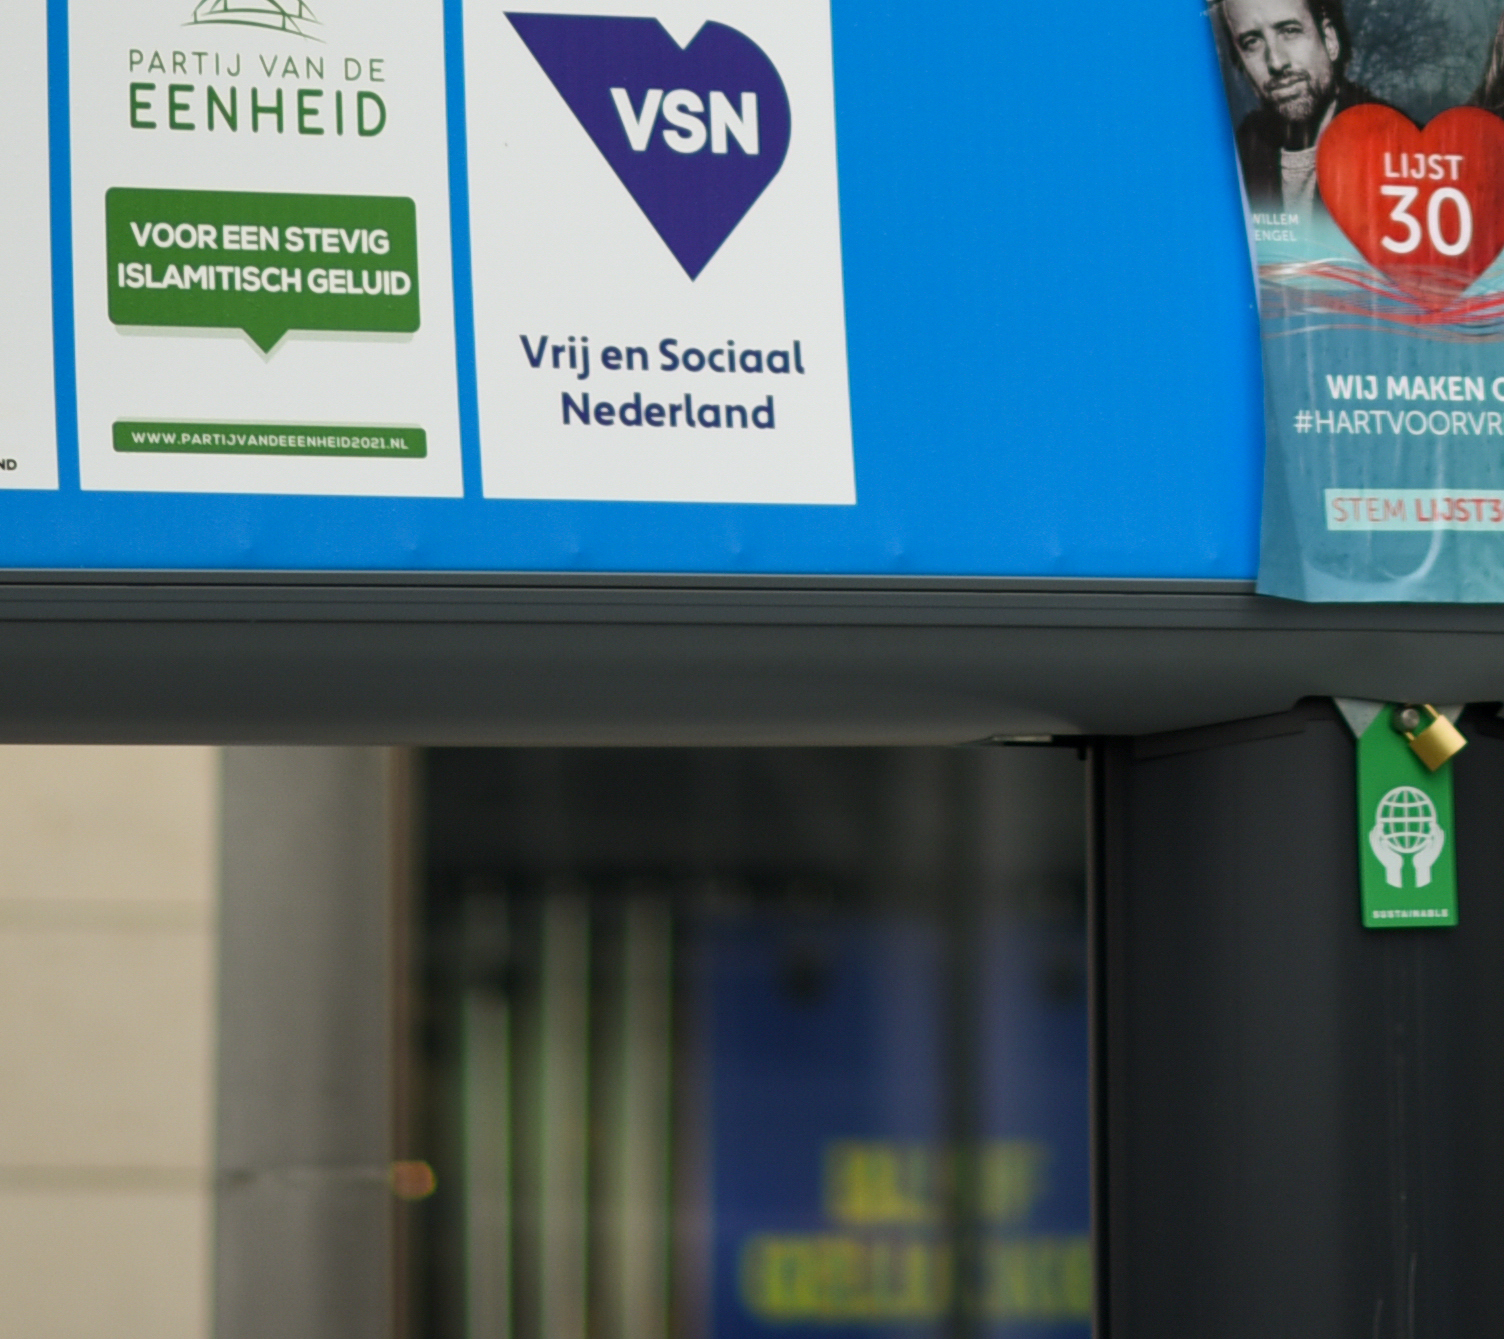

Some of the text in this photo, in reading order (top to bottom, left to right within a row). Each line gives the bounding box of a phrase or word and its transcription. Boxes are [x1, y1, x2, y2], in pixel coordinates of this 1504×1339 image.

[128, 49, 387, 83] PARTIJ VAN DE
[128, 82, 387, 138] EENHEID
[609, 87, 759, 156] VSN
[1384, 152, 1464, 181] LIJST
[1255, 229, 1297, 241] ENGEL
[1380, 184, 1473, 256] 30
[130, 221, 390, 257] VOOR EEN STEVIG
[117, 262, 411, 297] ISLAMITISCH GELUID
[519, 334, 805, 380] Vrij en Sociaal
[1326, 374, 1378, 401] WIJ
[1385, 375, 1485, 402] MAKEN
[560, 392, 775, 429] Nederland
[131, 431, 410, 451] WWW.PARTIJVANDEEENHEID2021.NL
[1331, 496, 1408, 523] STEM
[1372, 909, 1448, 918] SUSTAINABLE
